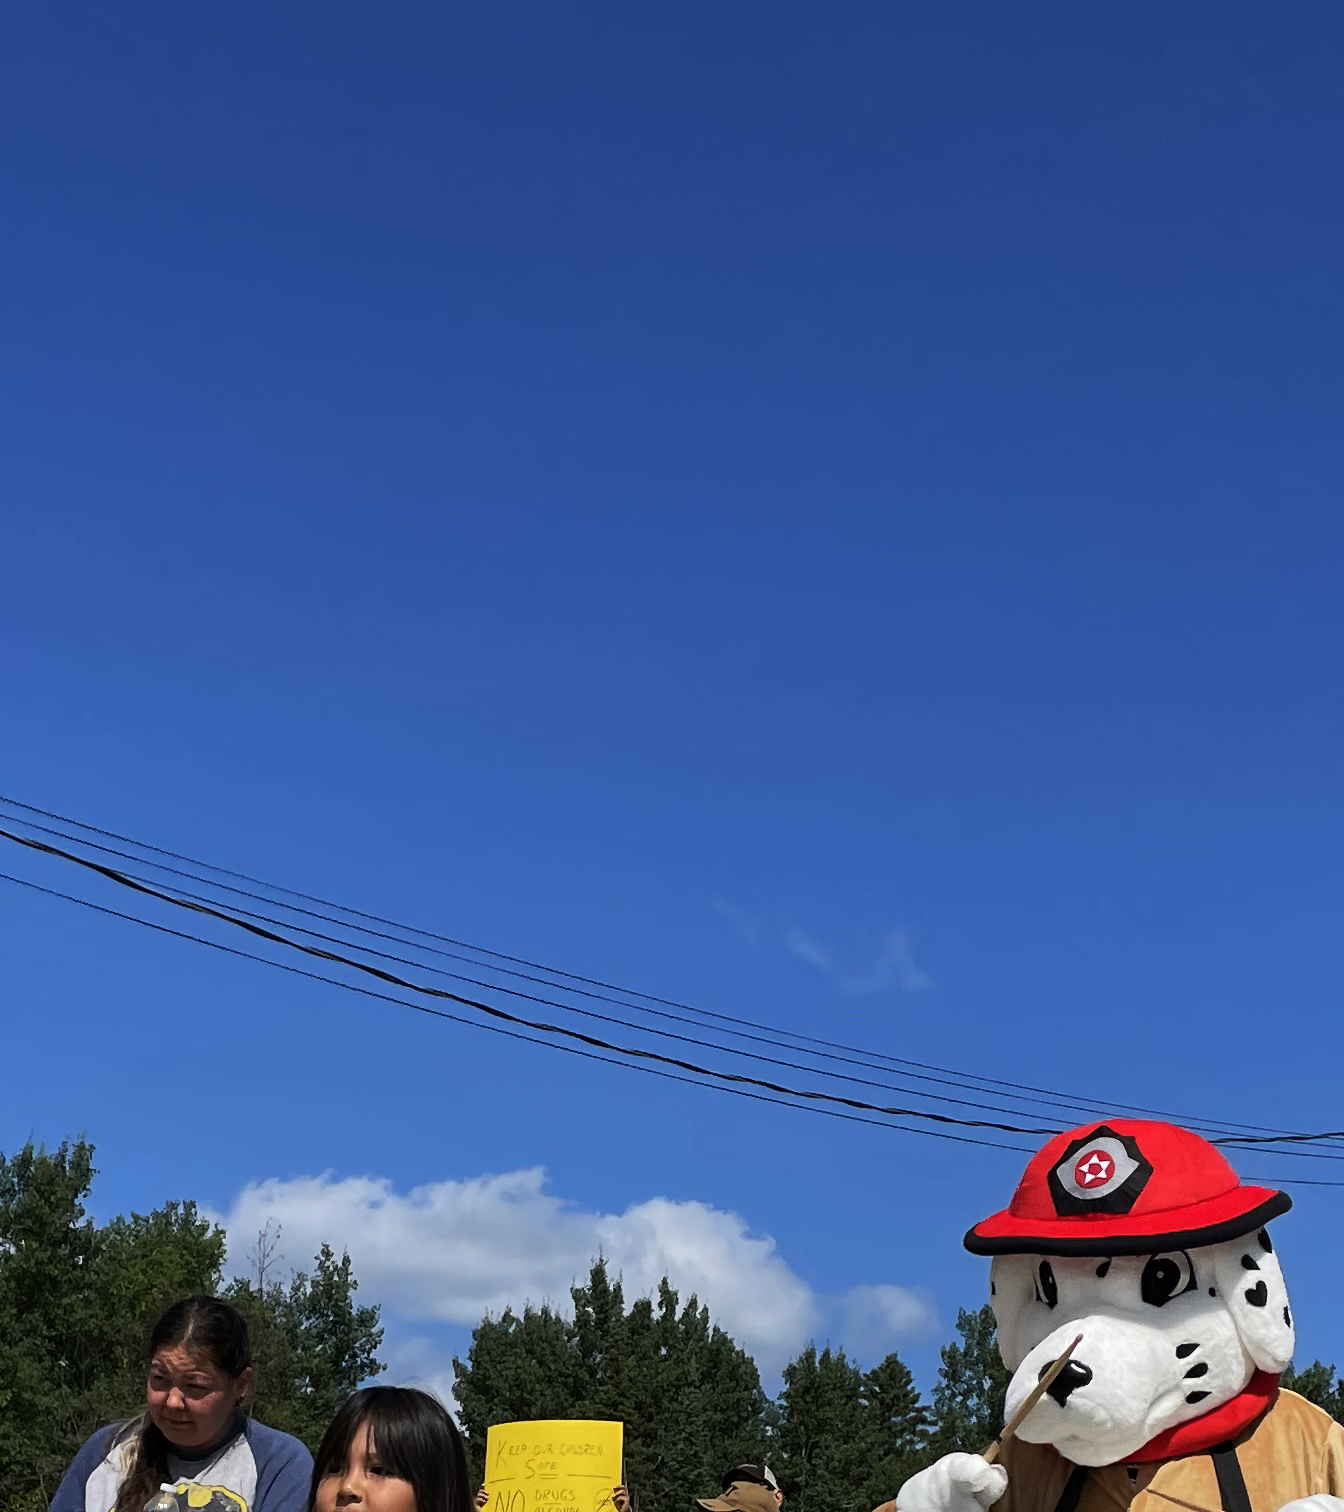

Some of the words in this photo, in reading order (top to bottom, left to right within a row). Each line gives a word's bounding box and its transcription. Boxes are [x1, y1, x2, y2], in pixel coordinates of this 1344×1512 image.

[495, 1439, 528, 1470] KEEP
[533, 1444, 555, 1456] OUR
[535, 1488, 576, 1502] DRUGS
